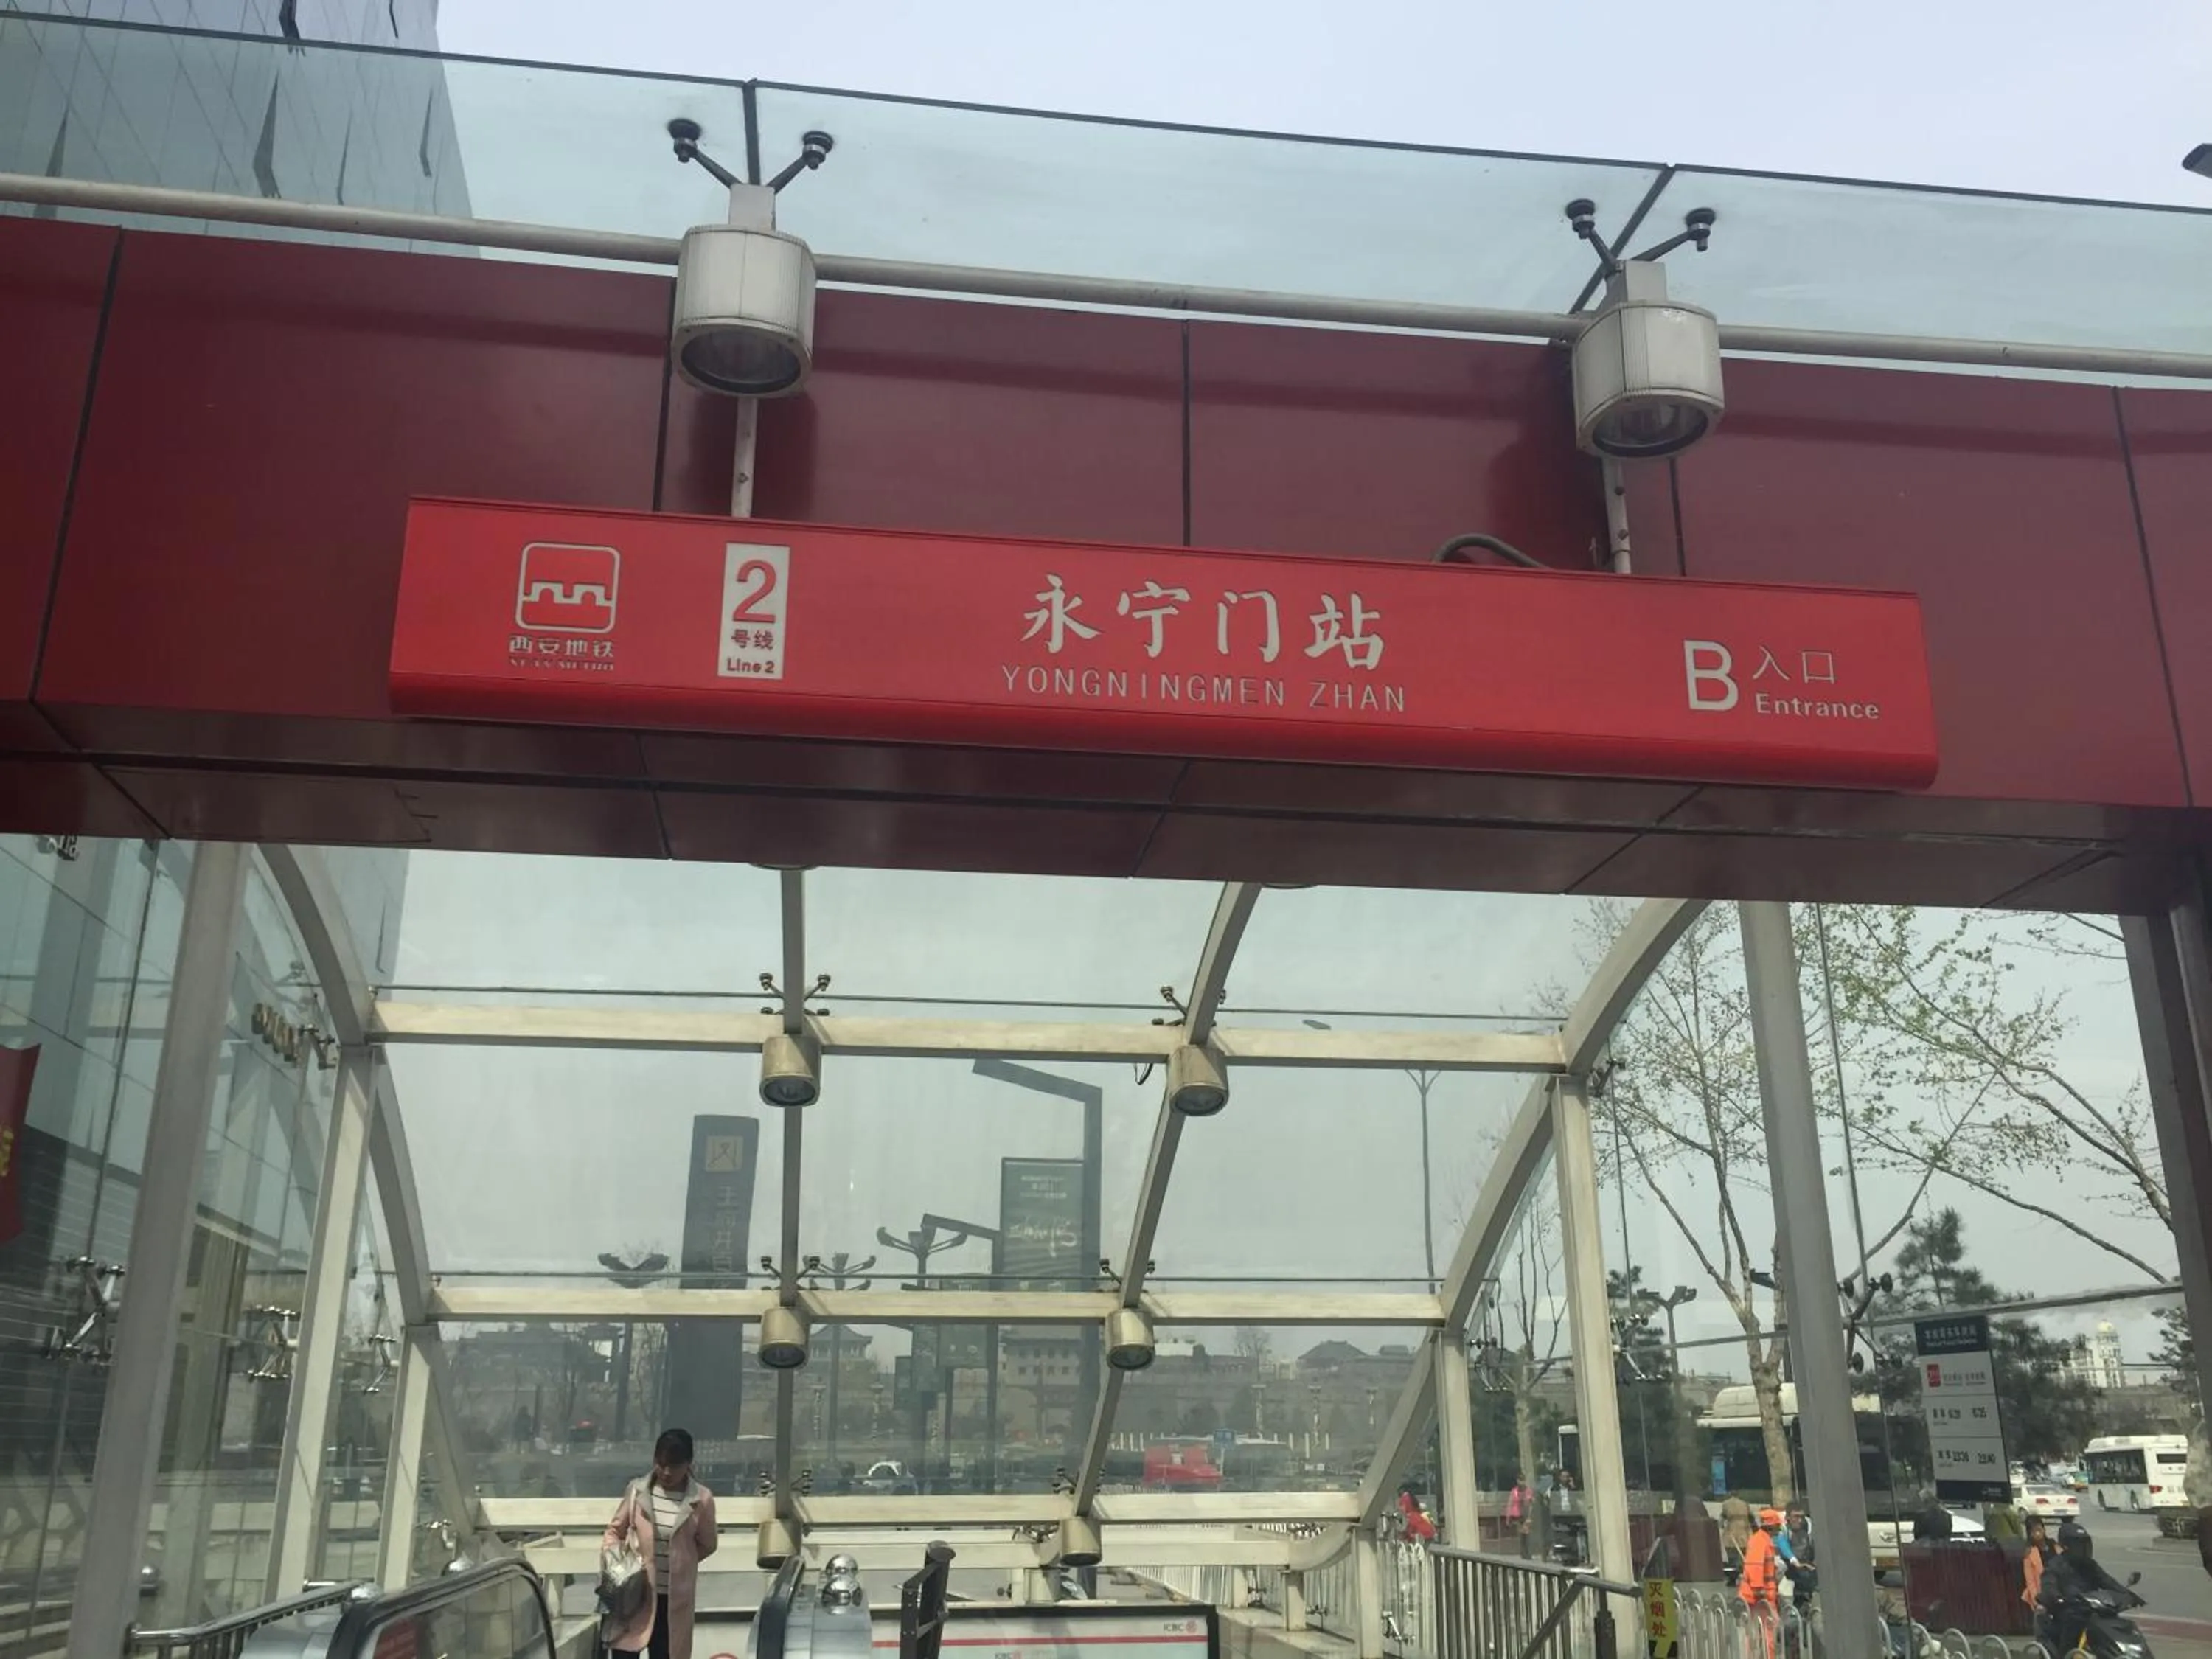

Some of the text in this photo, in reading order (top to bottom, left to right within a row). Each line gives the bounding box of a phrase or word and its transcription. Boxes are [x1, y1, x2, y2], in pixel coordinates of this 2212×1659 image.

[732, 560, 776, 623] 2
[1021, 574, 1385, 670] 永宁门站
[509, 635, 613, 658] 西安地铁
[731, 629, 773, 650] 号线
[727, 658, 776, 673] Line 2
[1684, 639, 1739, 711] B
[1753, 645, 1834, 684] 入口
[1002, 664, 1405, 712] YONGNINGMEN ZHAN
[1756, 692, 1879, 719] Entrance
[1163, 1623, 1185, 1632] ICBC
